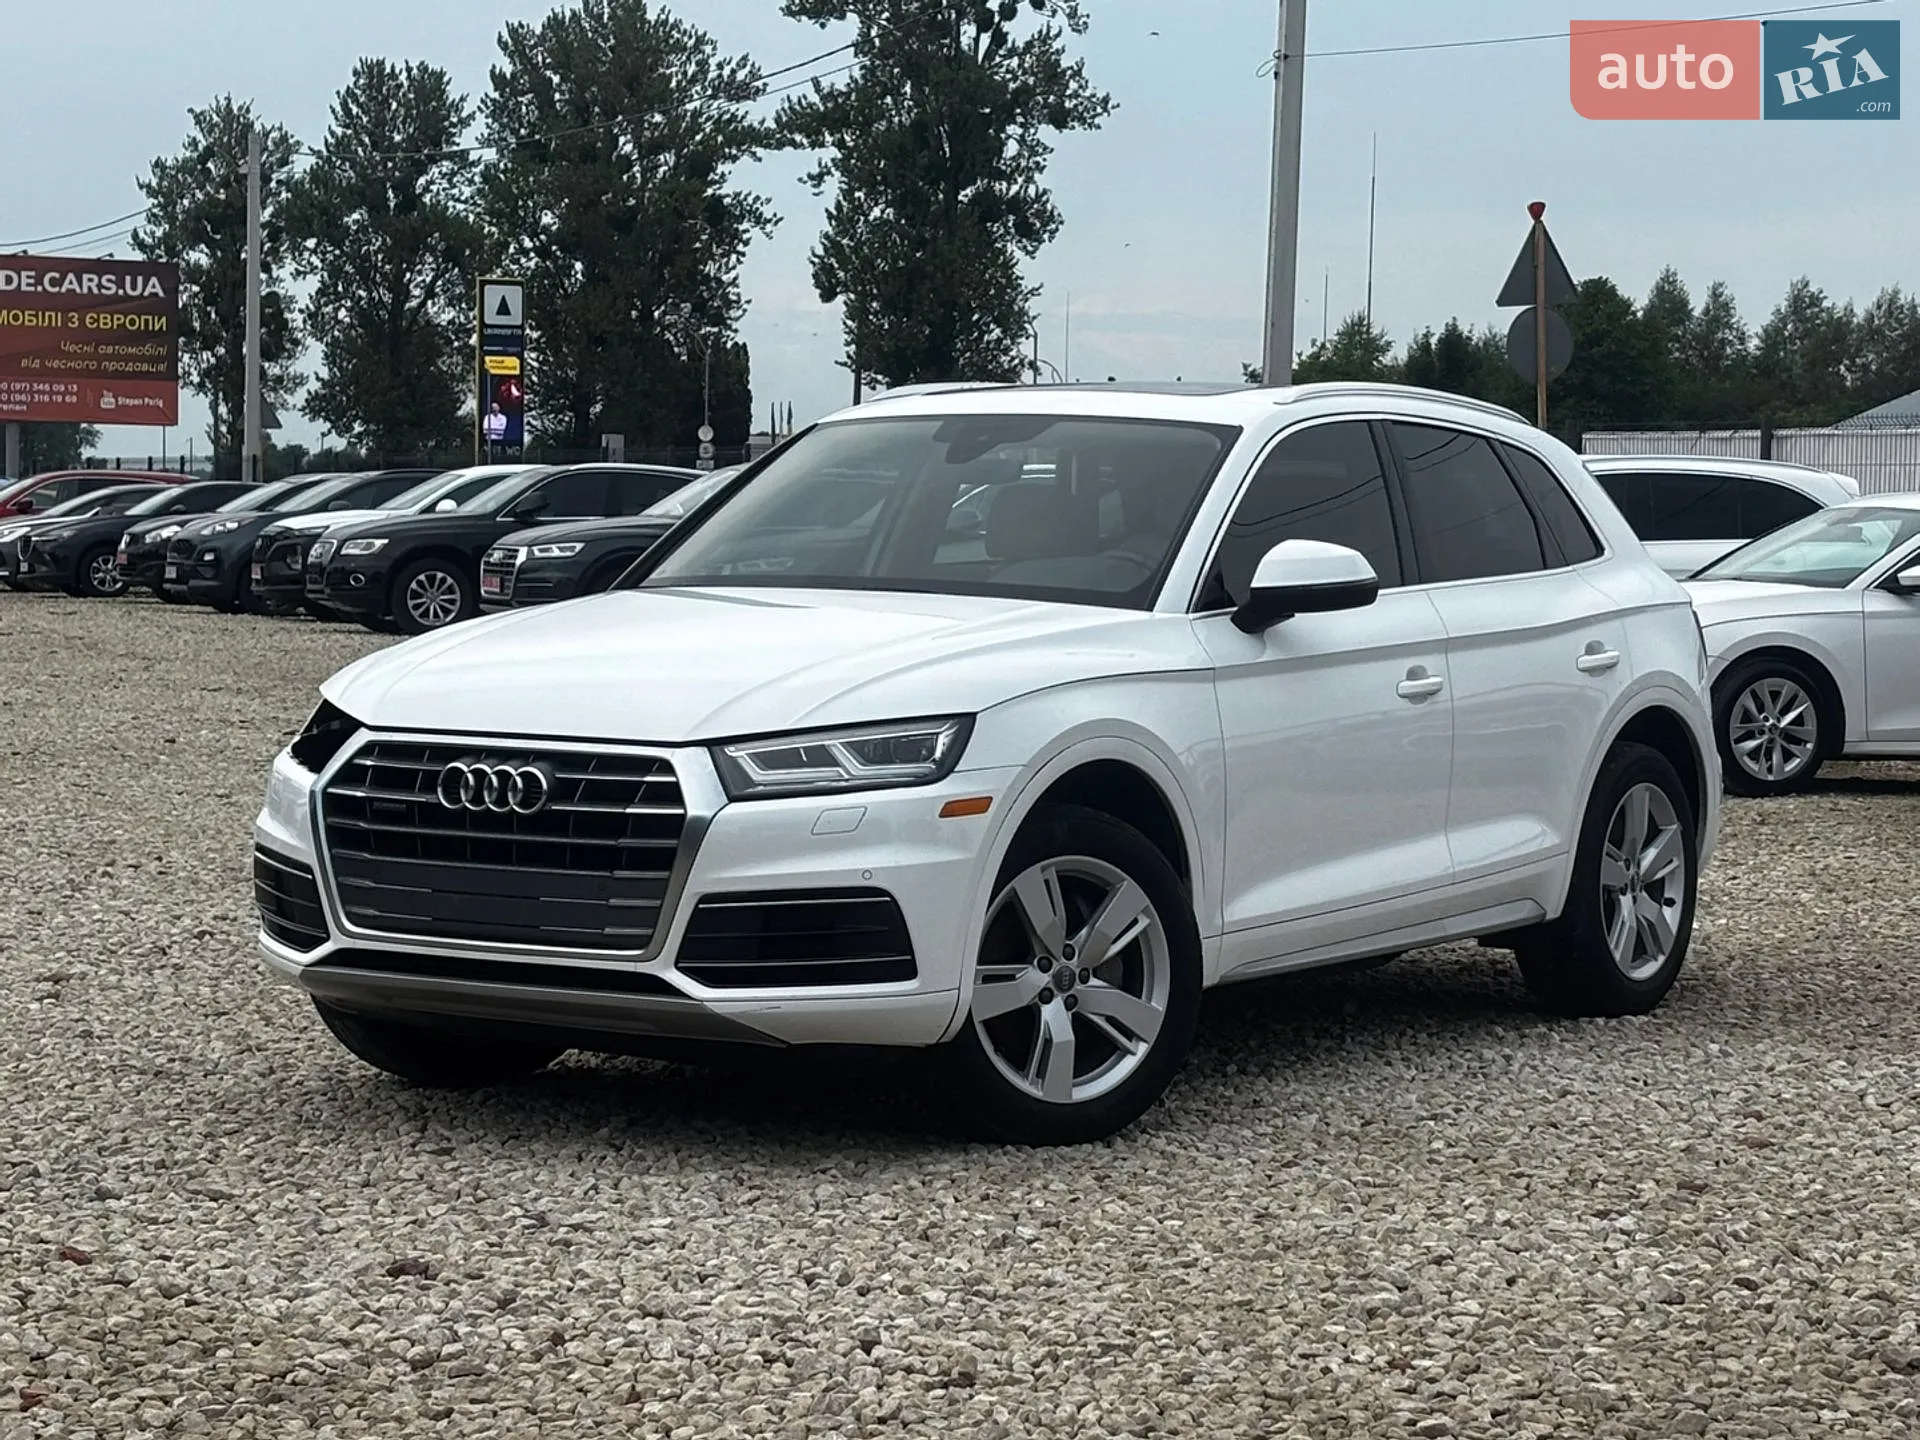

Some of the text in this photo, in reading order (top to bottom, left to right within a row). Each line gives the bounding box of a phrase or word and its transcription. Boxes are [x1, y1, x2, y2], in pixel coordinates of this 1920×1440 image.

[0, 269, 165, 298] DE.CARS.UA
[85, 313, 167, 332] ЄВРОПИ
[60, 340, 168, 357] Чесні автомобілі
[21, 356, 40, 369] від
[45, 359, 97, 371] чесного
